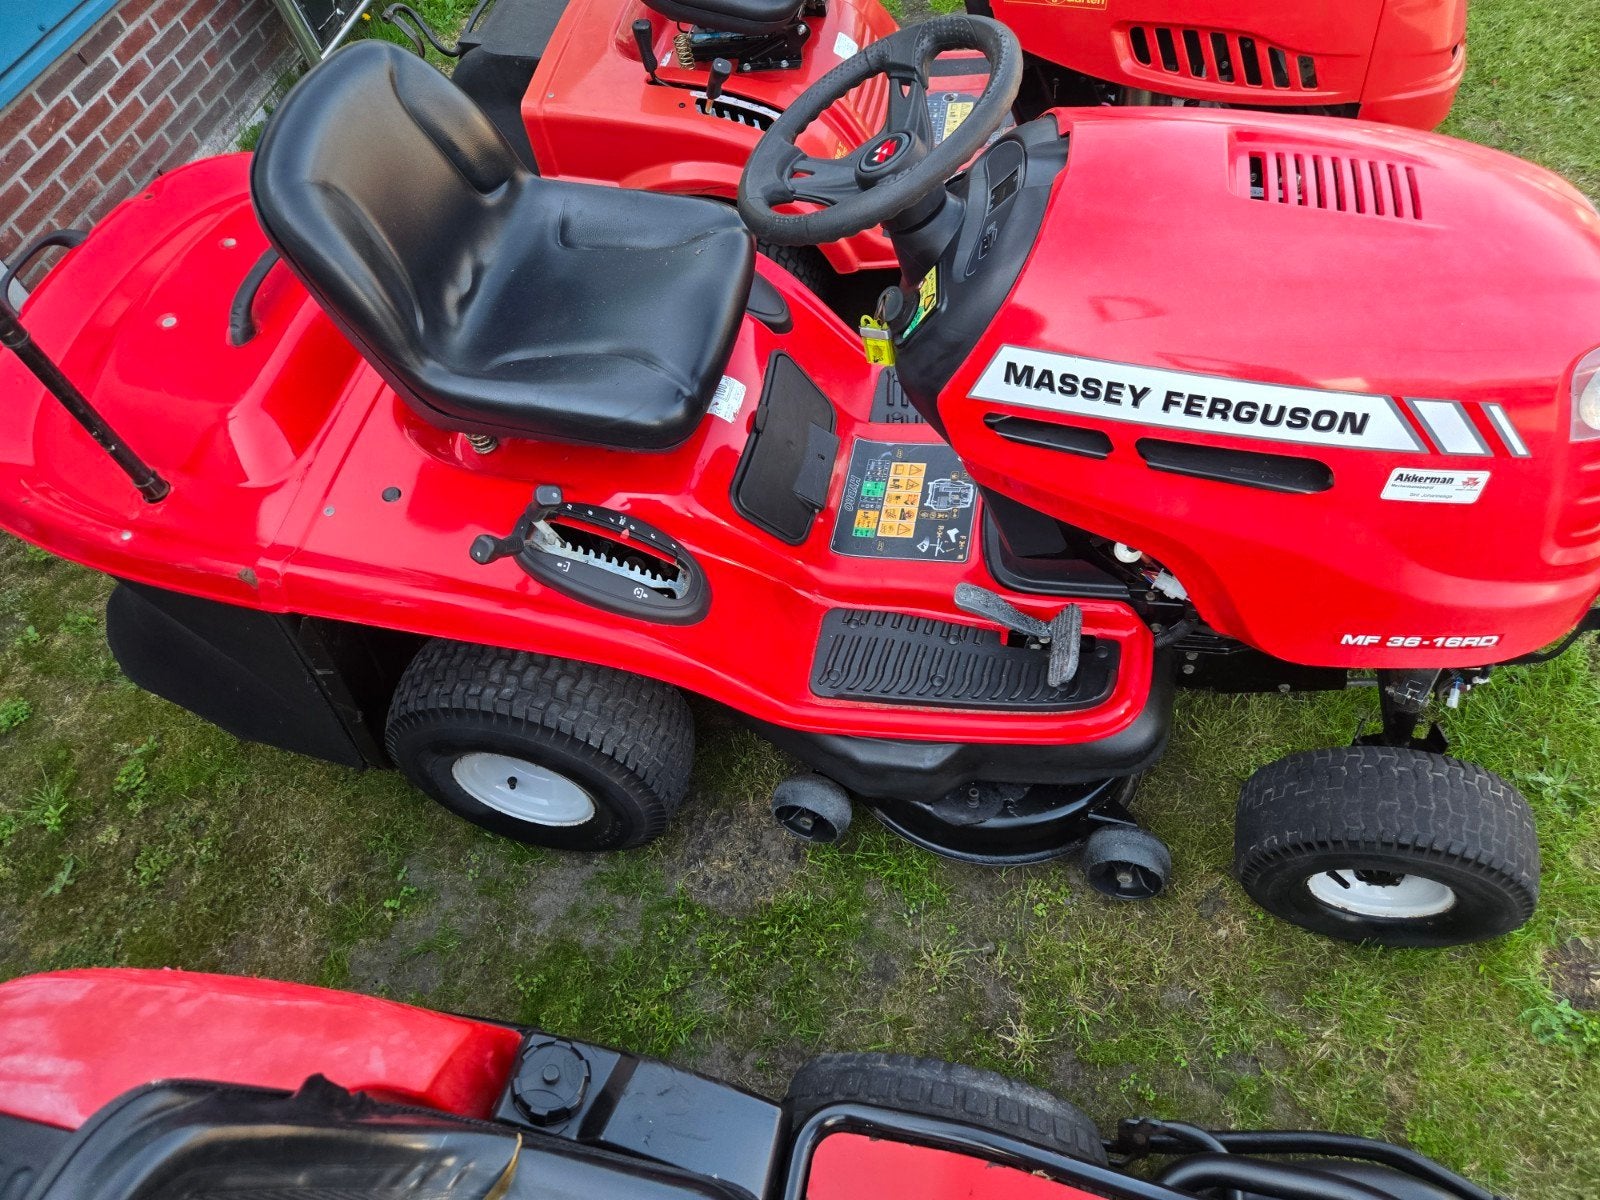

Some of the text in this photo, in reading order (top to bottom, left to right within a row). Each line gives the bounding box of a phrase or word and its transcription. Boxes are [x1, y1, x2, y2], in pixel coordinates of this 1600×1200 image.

[1003, 361, 1370, 436] MASSEY FERGUSON
[1394, 473, 1455, 485] Akkerman
[844, 475, 861, 511] HYDRO
[1341, 634, 1499, 648] MF 36-16RD
